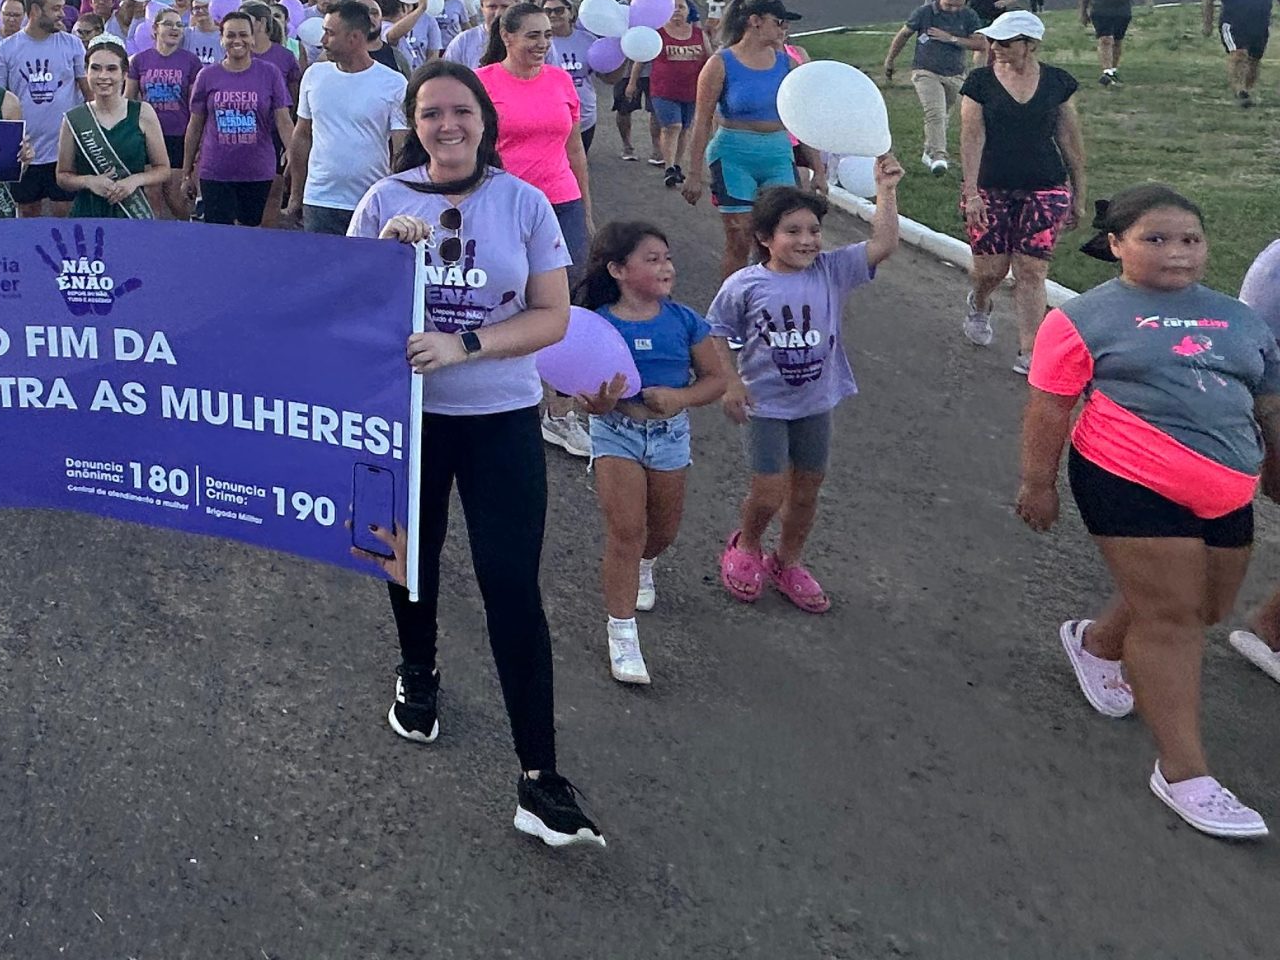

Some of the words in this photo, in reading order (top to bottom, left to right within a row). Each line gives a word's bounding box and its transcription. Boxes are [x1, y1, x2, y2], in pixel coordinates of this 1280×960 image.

[668, 46, 702, 55] BOSS
[214, 91, 221, 103] O
[223, 91, 258, 103] DESEJO
[62, 256, 105, 274] NÃO
[425, 262, 487, 288] NÃO
[25, 326, 98, 359] FIM
[114, 328, 177, 365] DA
[769, 329, 820, 348] NÃO
[90, 380, 147, 416] AS
[161, 385, 404, 460] MULHERES!
[65, 457, 124, 473] Denuncia
[129, 462, 189, 497] 180
[205, 476, 266, 497] Denuncia
[67, 484, 95, 494] Central
[96, 487, 106, 496] de
[206, 488, 248, 506] Crime:
[206, 506, 237, 518] Brigada
[272, 486, 336, 526] 190
